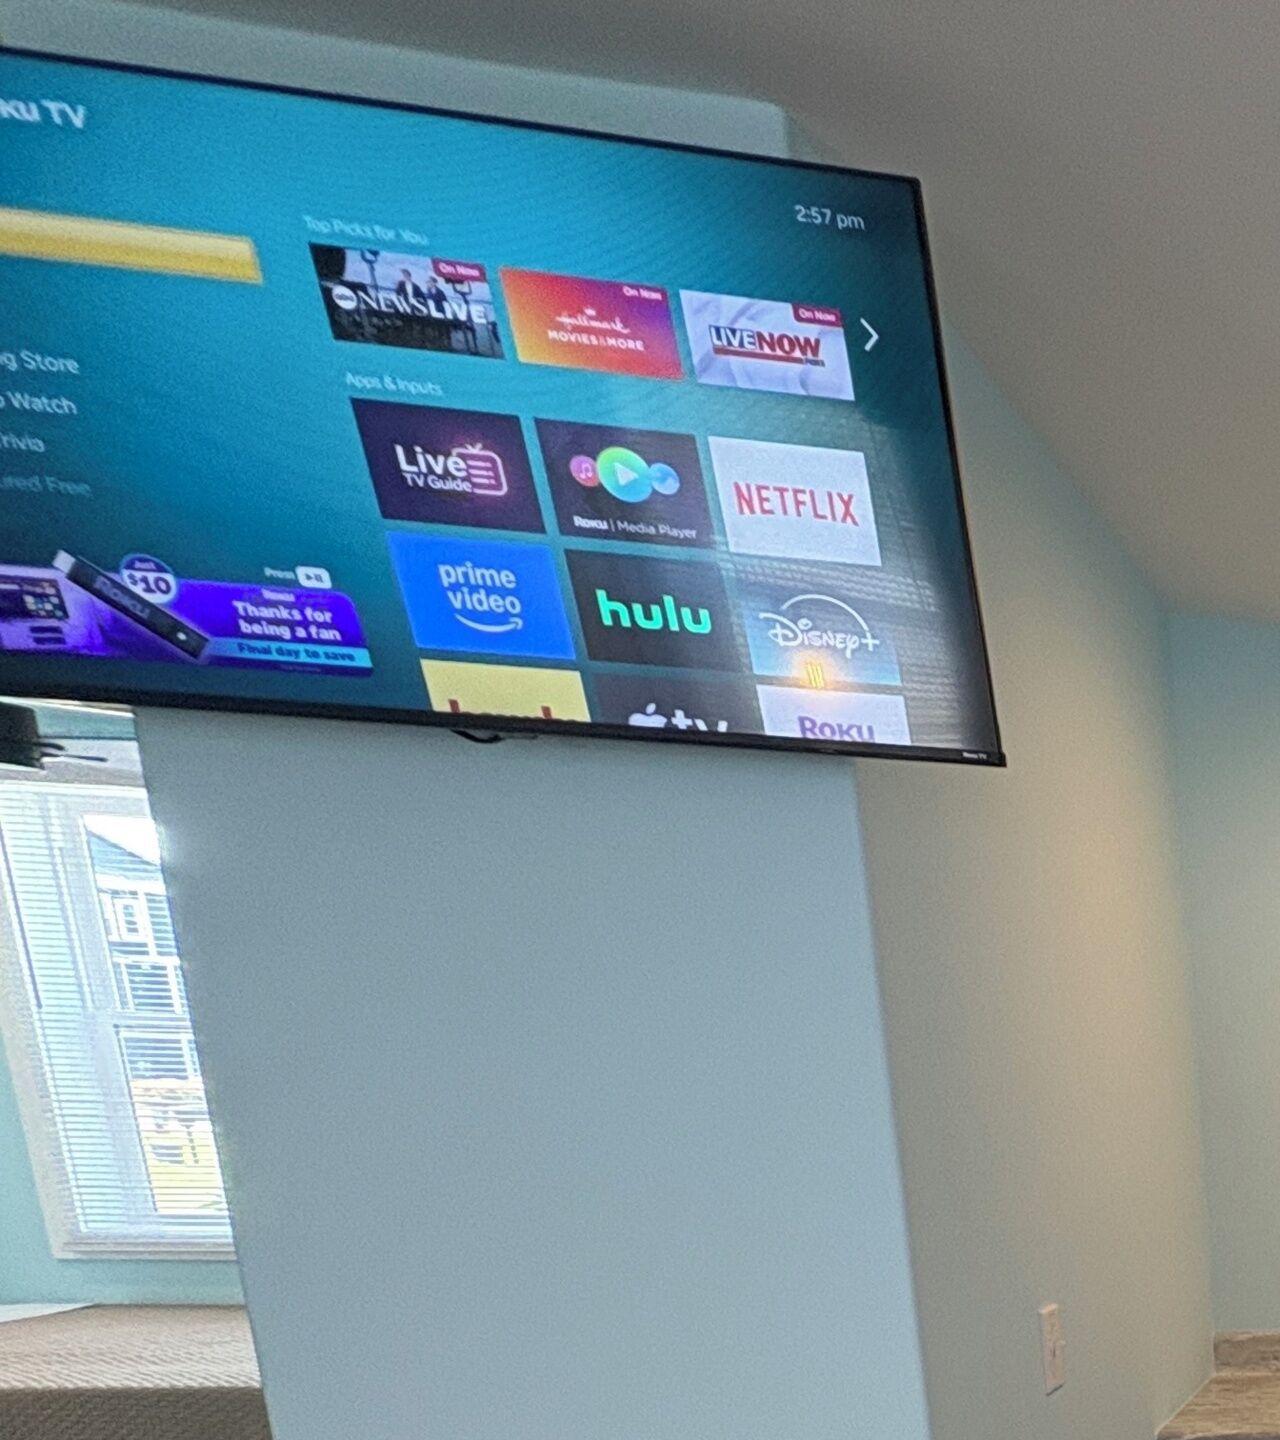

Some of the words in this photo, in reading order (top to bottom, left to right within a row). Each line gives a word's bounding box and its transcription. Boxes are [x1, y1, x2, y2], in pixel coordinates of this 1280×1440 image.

[41, 99, 86, 129] TV
[795, 205, 831, 224] 2:57
[837, 213, 865, 230] pm
[19, 350, 80, 374] Store
[346, 372, 384, 390] Apps
[6, 391, 77, 415] Watch
[394, 444, 468, 477] Live
[402, 472, 425, 488] TV
[428, 475, 473, 493] Guide
[733, 481, 859, 527] NETFLIX
[616, 520, 656, 534] Media
[658, 524, 697, 539] Player
[127, 573, 171, 595] $10
[438, 562, 516, 589] prime
[232, 600, 303, 621] Thanks
[304, 606, 332, 624] for
[446, 587, 521, 614] video
[595, 589, 711, 634] hulu
[238, 619, 291, 640] being
[294, 626, 307, 638] a
[309, 625, 342, 641] fan
[237, 642, 272, 656] Final
[275, 646, 300, 660] day
[304, 648, 320, 659] to
[323, 651, 355, 662] save
